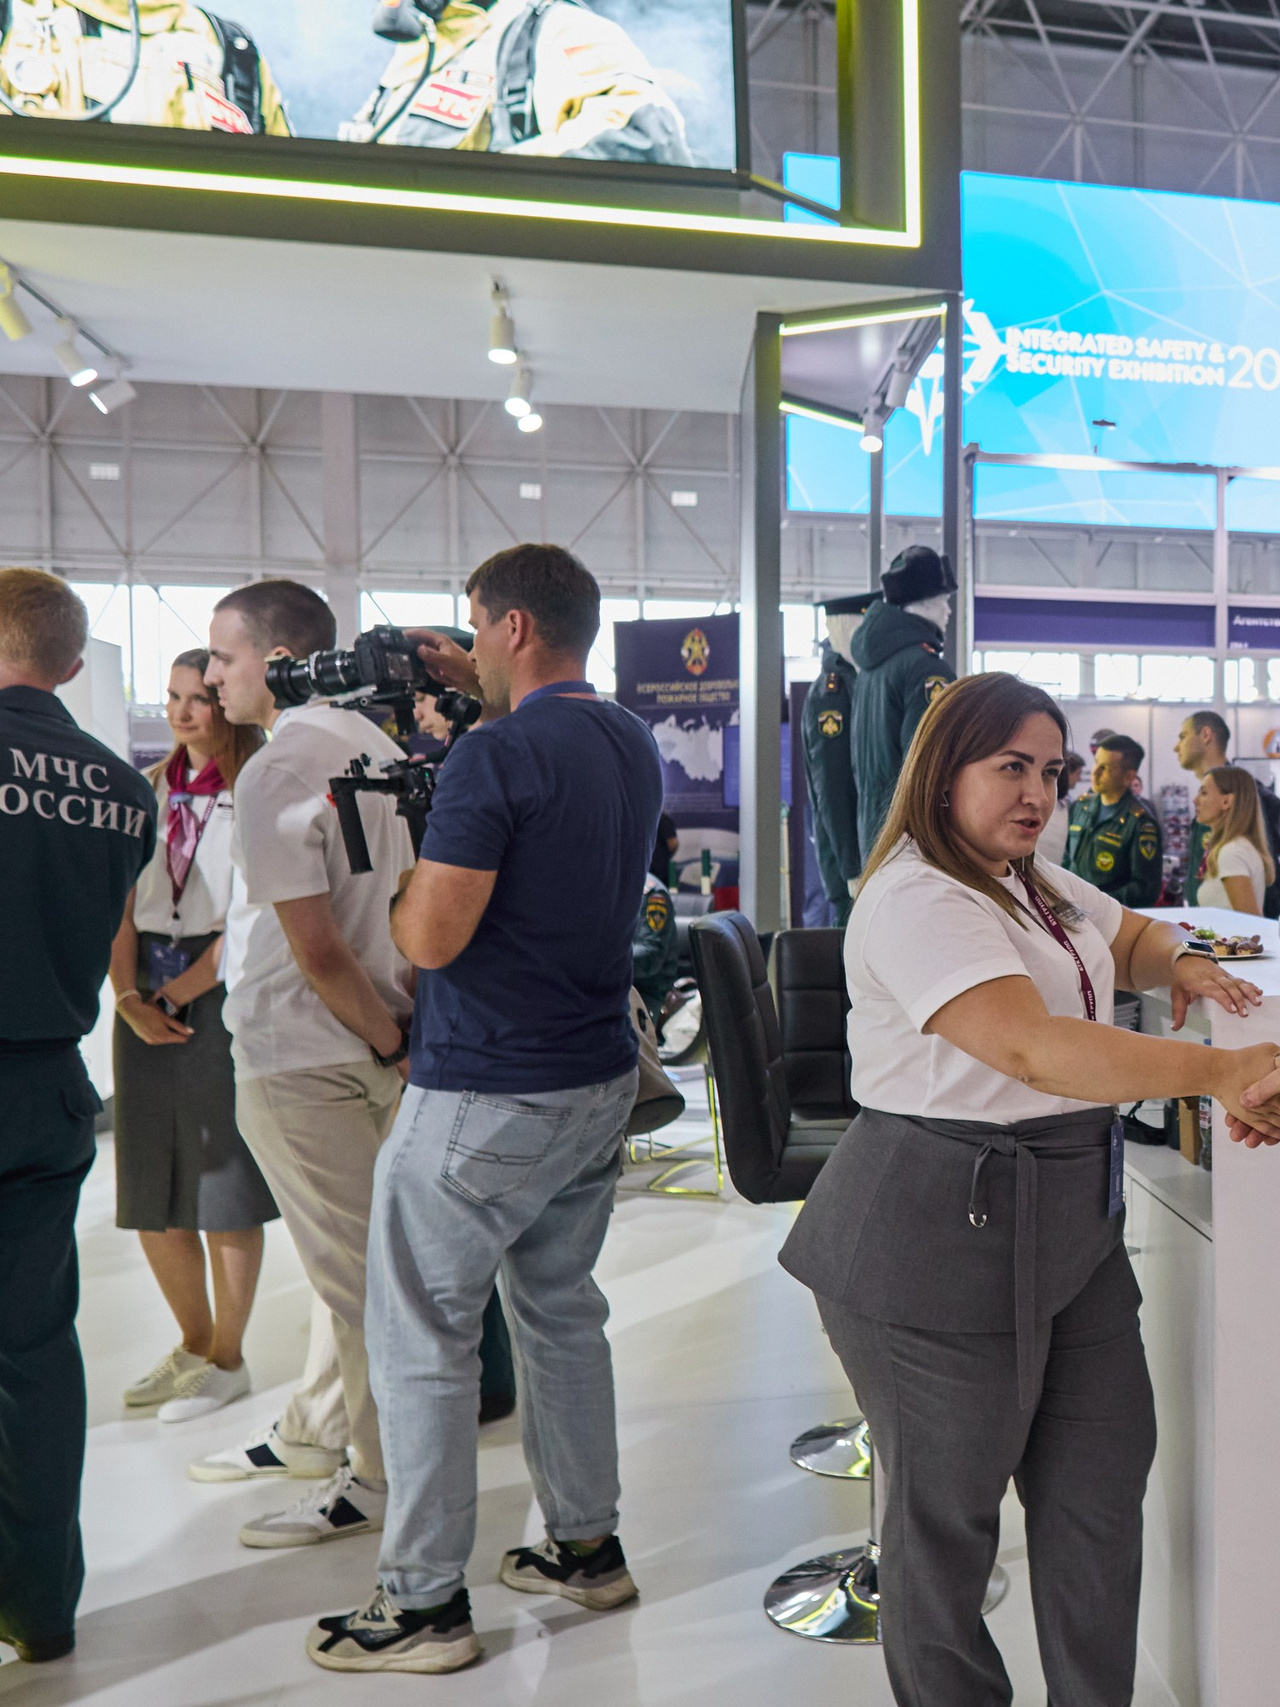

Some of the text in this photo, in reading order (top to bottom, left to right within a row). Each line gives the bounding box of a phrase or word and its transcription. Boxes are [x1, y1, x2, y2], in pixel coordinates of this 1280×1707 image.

[1005, 328, 1225, 364] INTEGRATED SAFETY &
[1005, 352, 1225, 386] SECURITY EXHIBITION
[9, 748, 110, 793] МЧС
